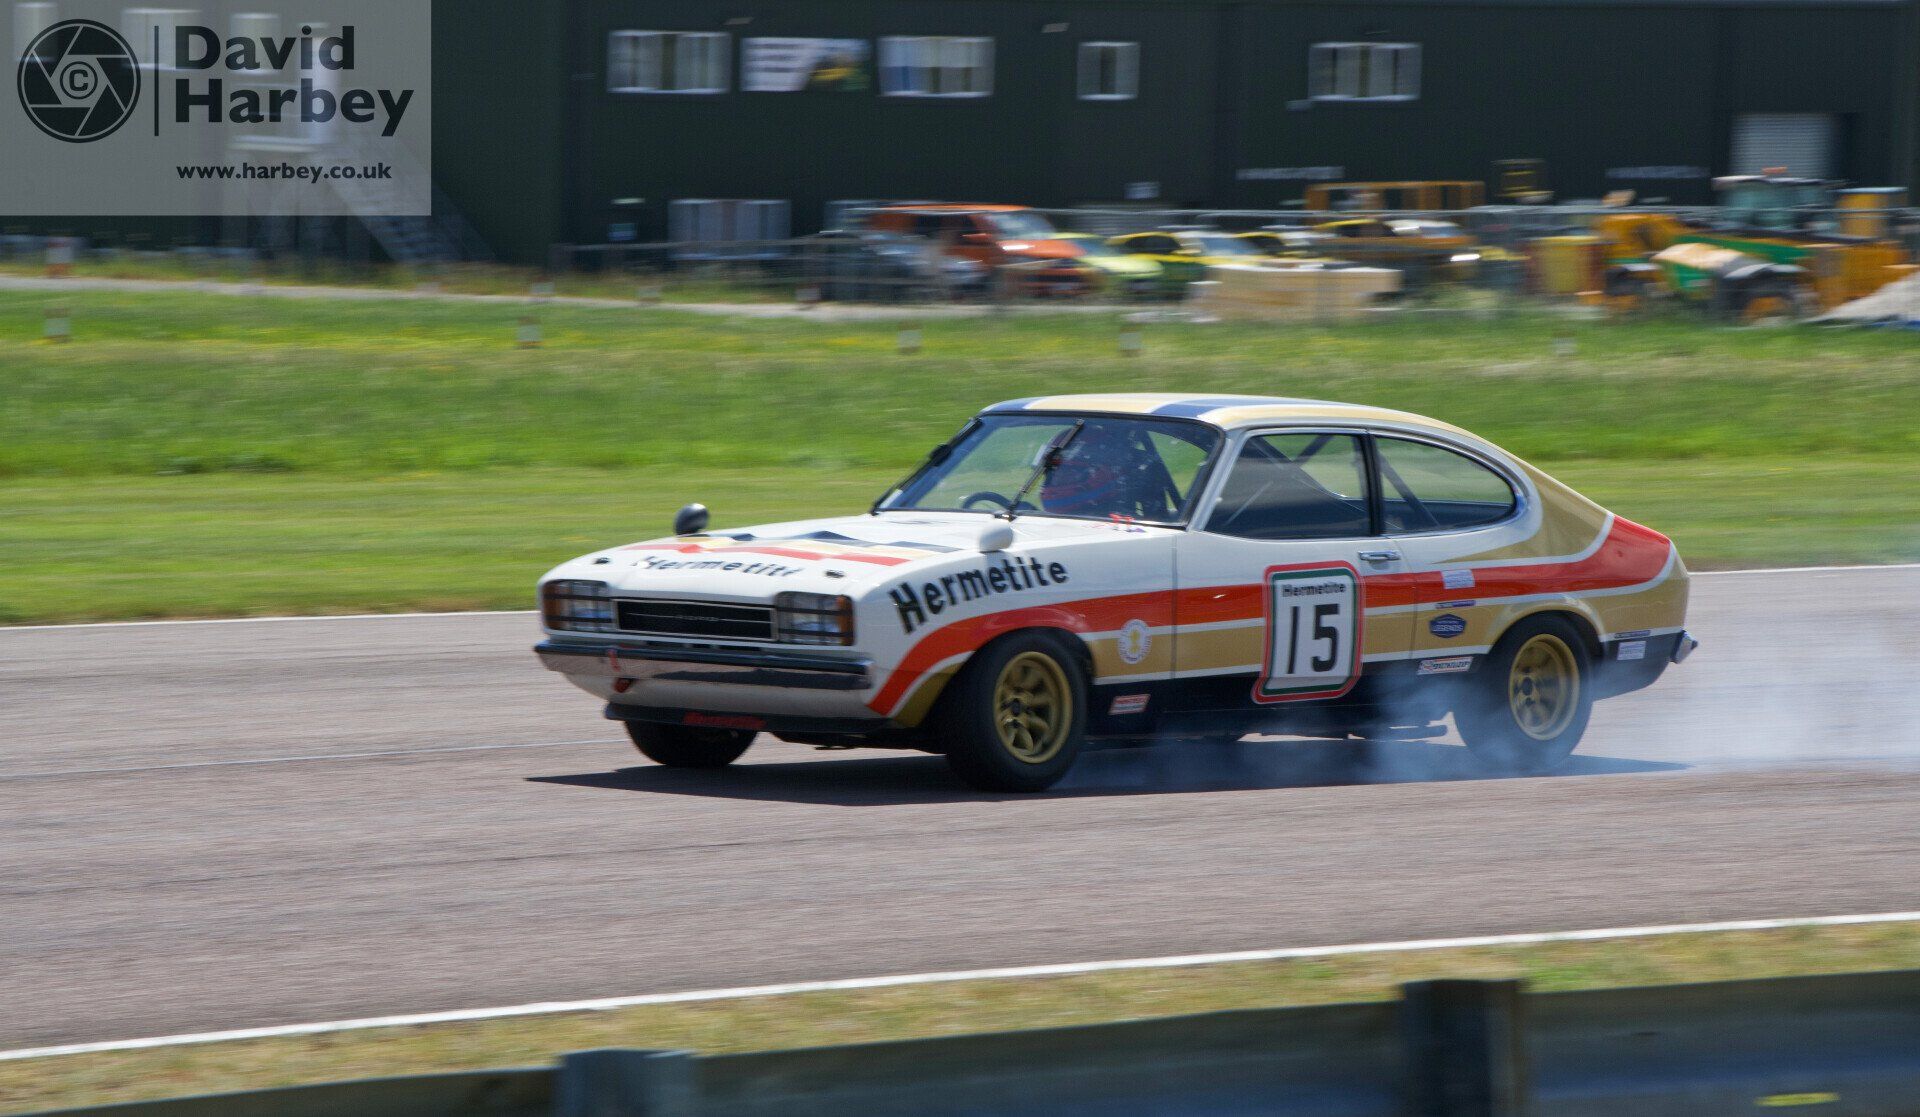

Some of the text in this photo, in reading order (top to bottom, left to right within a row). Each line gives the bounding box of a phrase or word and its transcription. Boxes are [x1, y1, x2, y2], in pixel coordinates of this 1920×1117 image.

[889, 556, 1069, 633] Hermetite
[1282, 582, 1346, 597] Hermetite
[1287, 603, 1340, 675] 15
